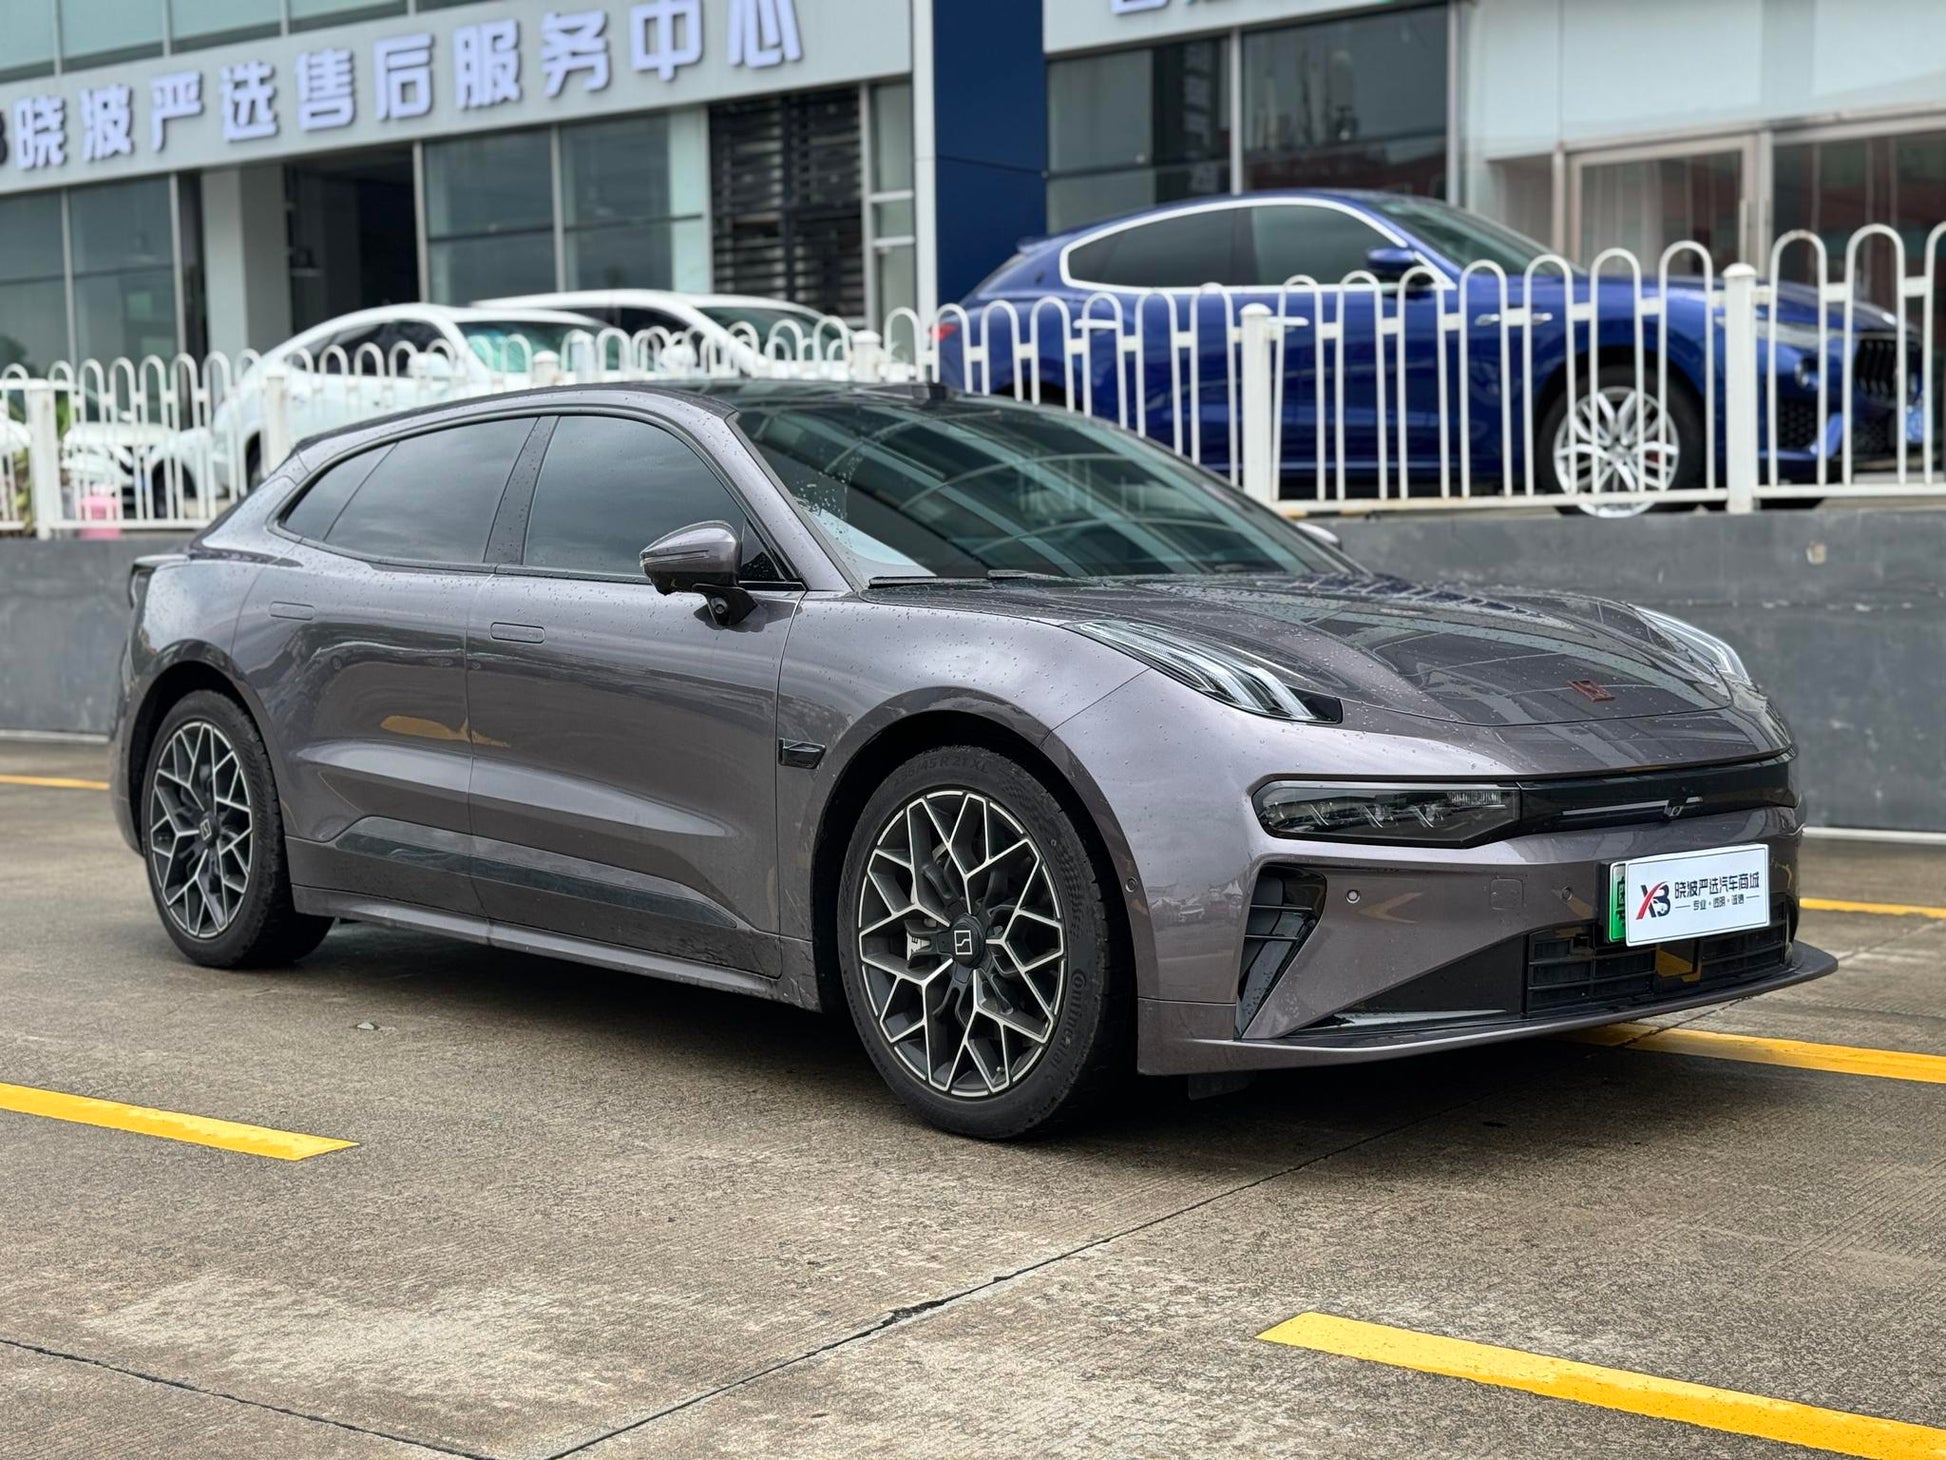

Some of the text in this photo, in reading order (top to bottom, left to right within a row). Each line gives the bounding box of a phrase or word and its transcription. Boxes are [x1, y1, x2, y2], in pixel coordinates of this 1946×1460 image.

[14, 0, 803, 170] 晓波严选售后服务中心
[1675, 872, 1759, 899] 晓波严选汽车商城
